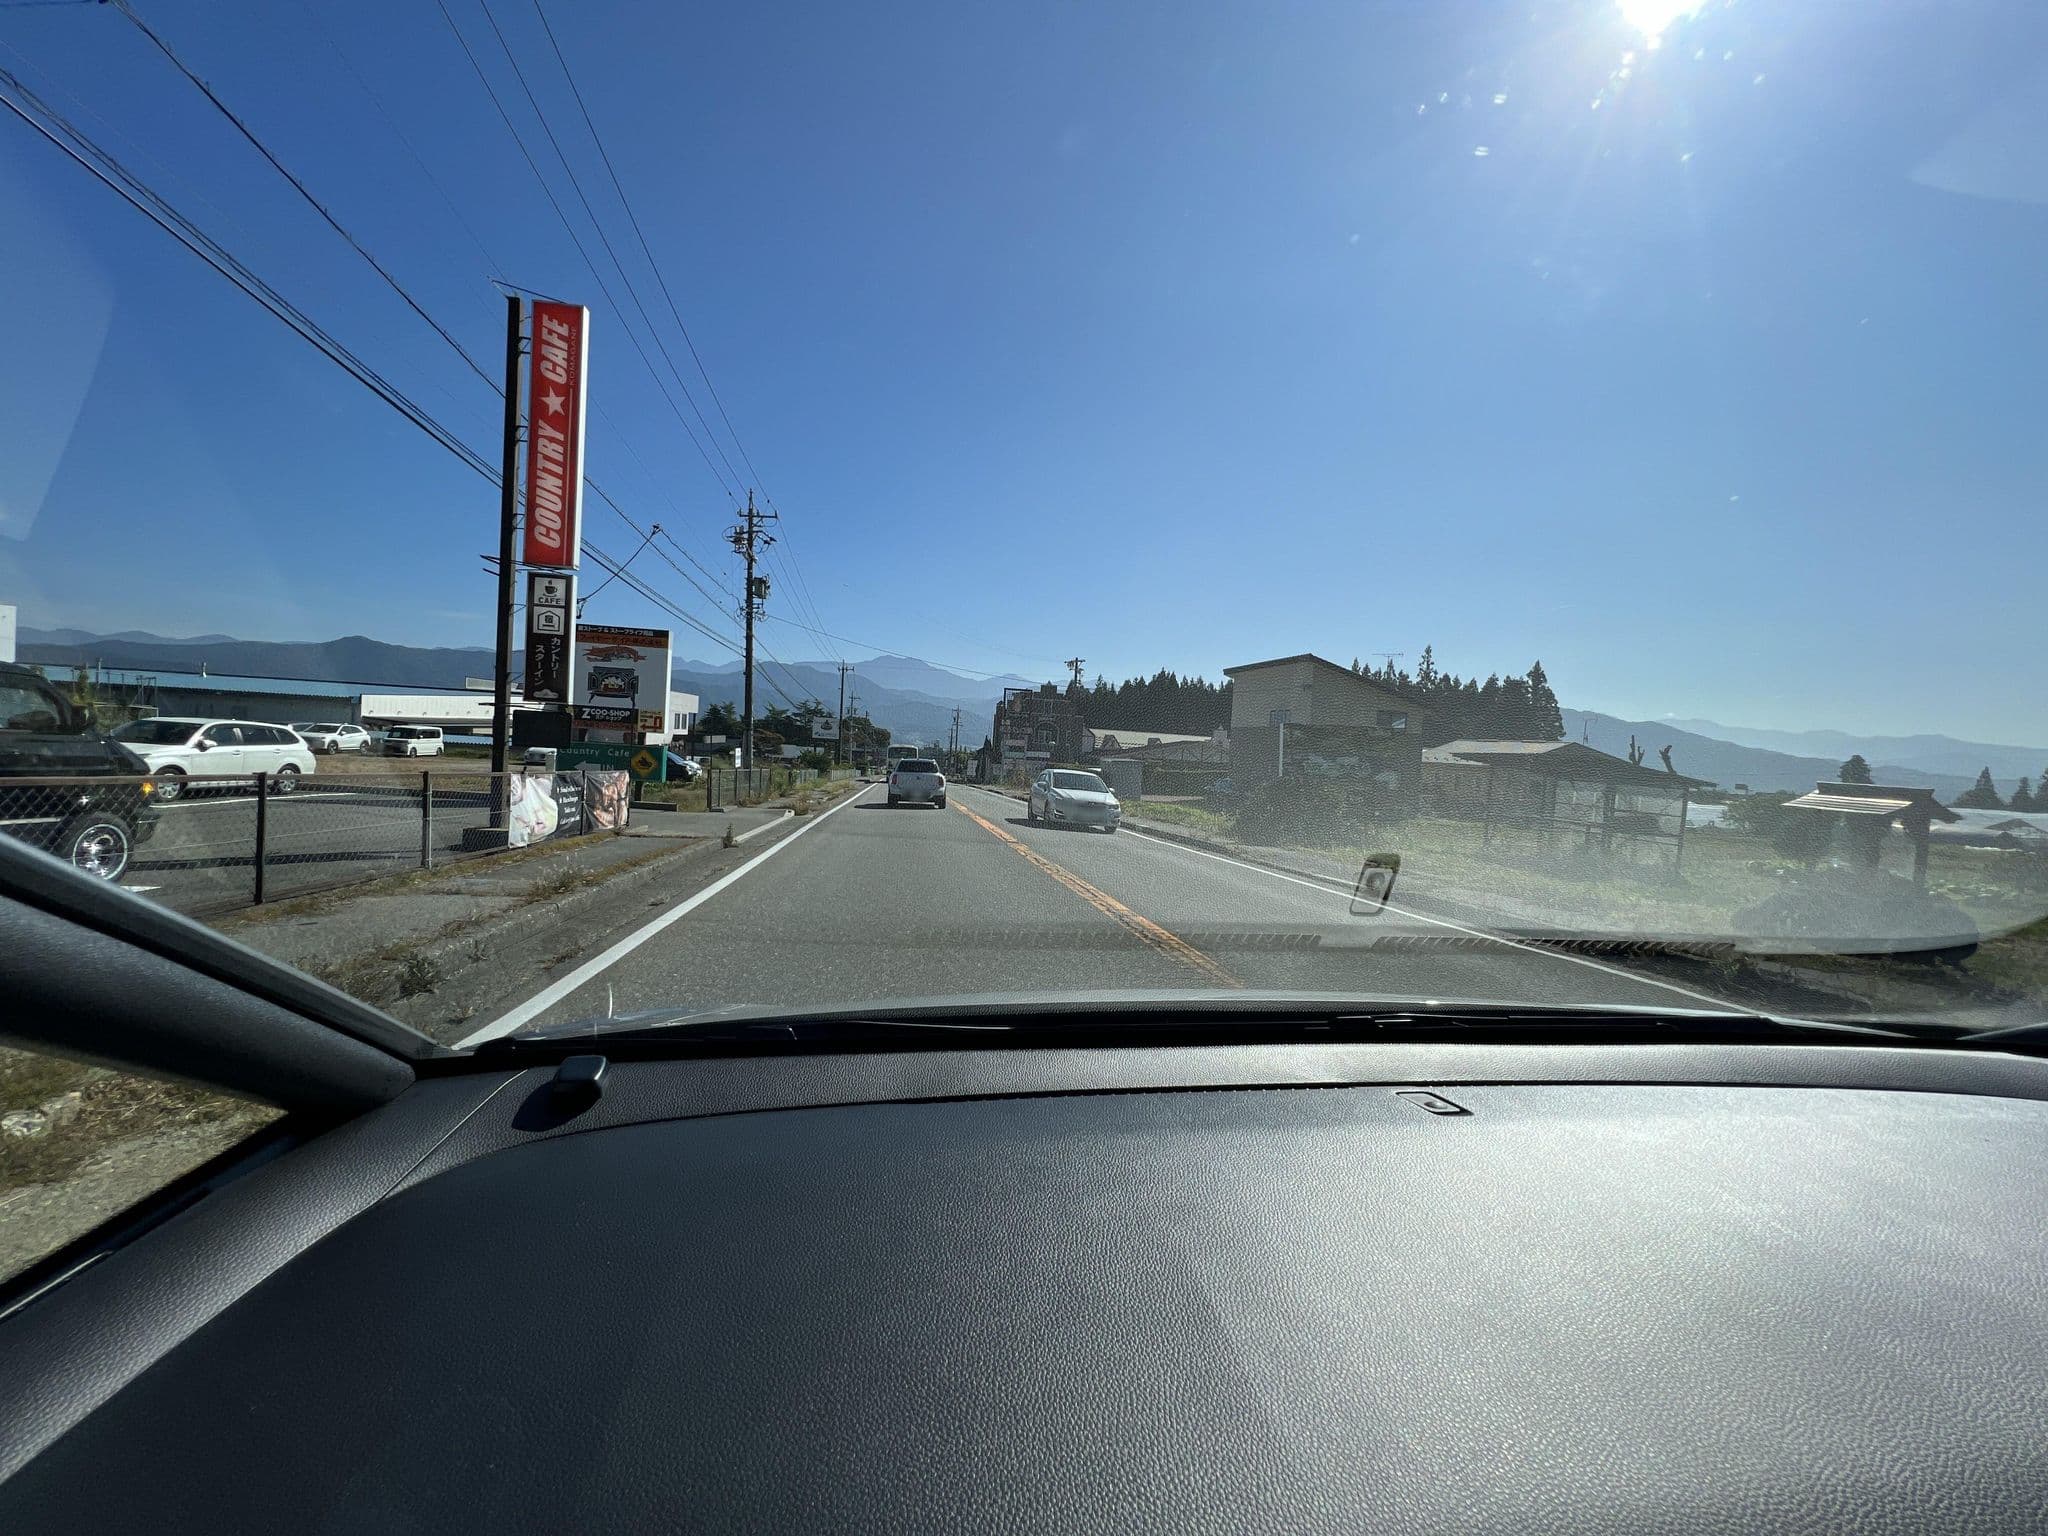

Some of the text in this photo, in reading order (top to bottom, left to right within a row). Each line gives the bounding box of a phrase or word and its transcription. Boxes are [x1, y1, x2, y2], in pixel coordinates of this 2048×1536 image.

[541, 314, 570, 385] CAFE
[533, 419, 566, 549] COUNTRY
[538, 596, 561, 605] CAFE
[534, 645, 545, 686] スターイン
[551, 637, 561, 679] カントリー
[607, 748, 630, 758] Cafe
